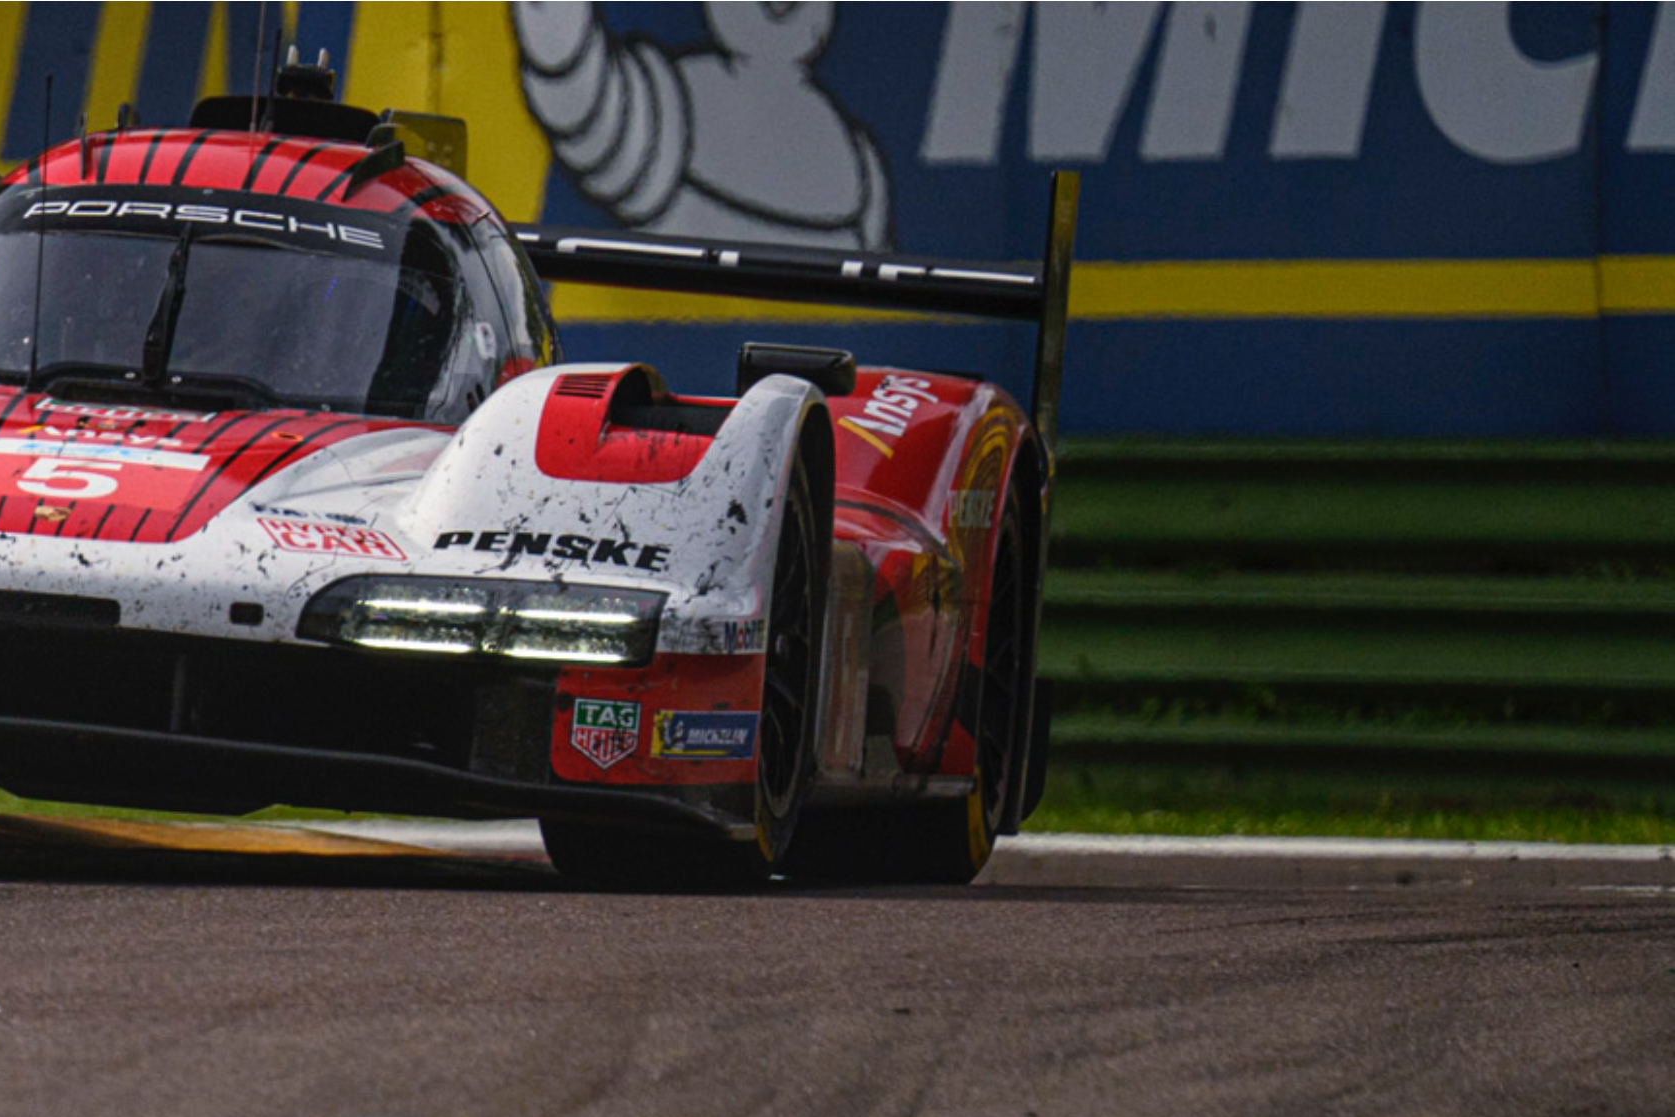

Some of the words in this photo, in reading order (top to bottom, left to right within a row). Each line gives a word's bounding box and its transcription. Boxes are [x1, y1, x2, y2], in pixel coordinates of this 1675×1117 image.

[918, 2, 1674, 162] MIC
[23, 200, 385, 249] PORSCHE
[837, 374, 939, 459] Ansys
[16, 457, 123, 499] 5
[280, 532, 394, 557] CAR
[433, 531, 671, 572] PENSKE
[581, 704, 634, 728] TAG
